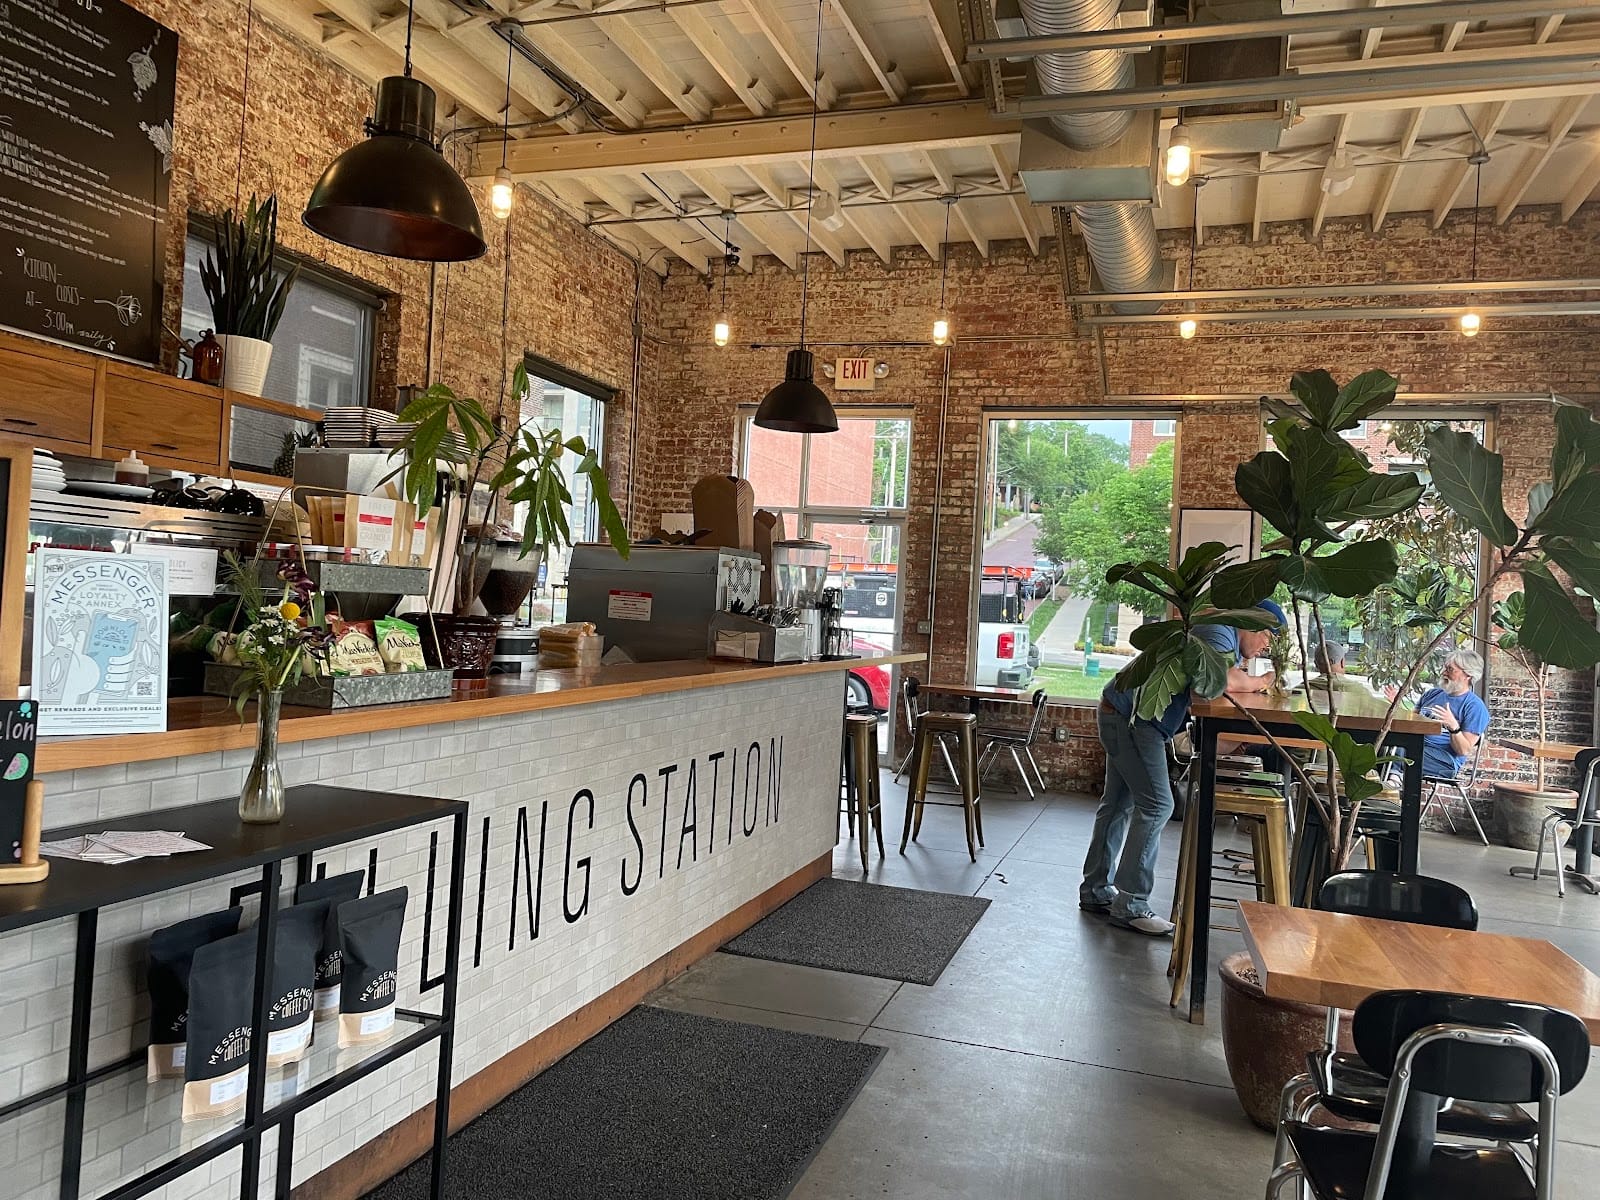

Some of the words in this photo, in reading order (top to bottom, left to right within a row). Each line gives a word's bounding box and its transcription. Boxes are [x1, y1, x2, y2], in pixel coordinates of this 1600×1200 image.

[23, 256, 57, 284] KITCHEN
[56, 284, 80, 306] CLOSES
[843, 359, 869, 379] EXIT
[51, 564, 156, 610] MESSENGER
[79, 591, 129, 601] LOYALTY
[85, 600, 123, 609] ANNEX
[620, 735, 785, 897] STATION
[314, 949, 343, 980] MESSEN
[360, 970, 398, 1002] MESSENG
[373, 979, 391, 1000] COFFEE
[281, 997, 303, 1019] COFFEE
[208, 1026, 252, 1065] MESSENG
[223, 1037, 243, 1062] COFFEE
